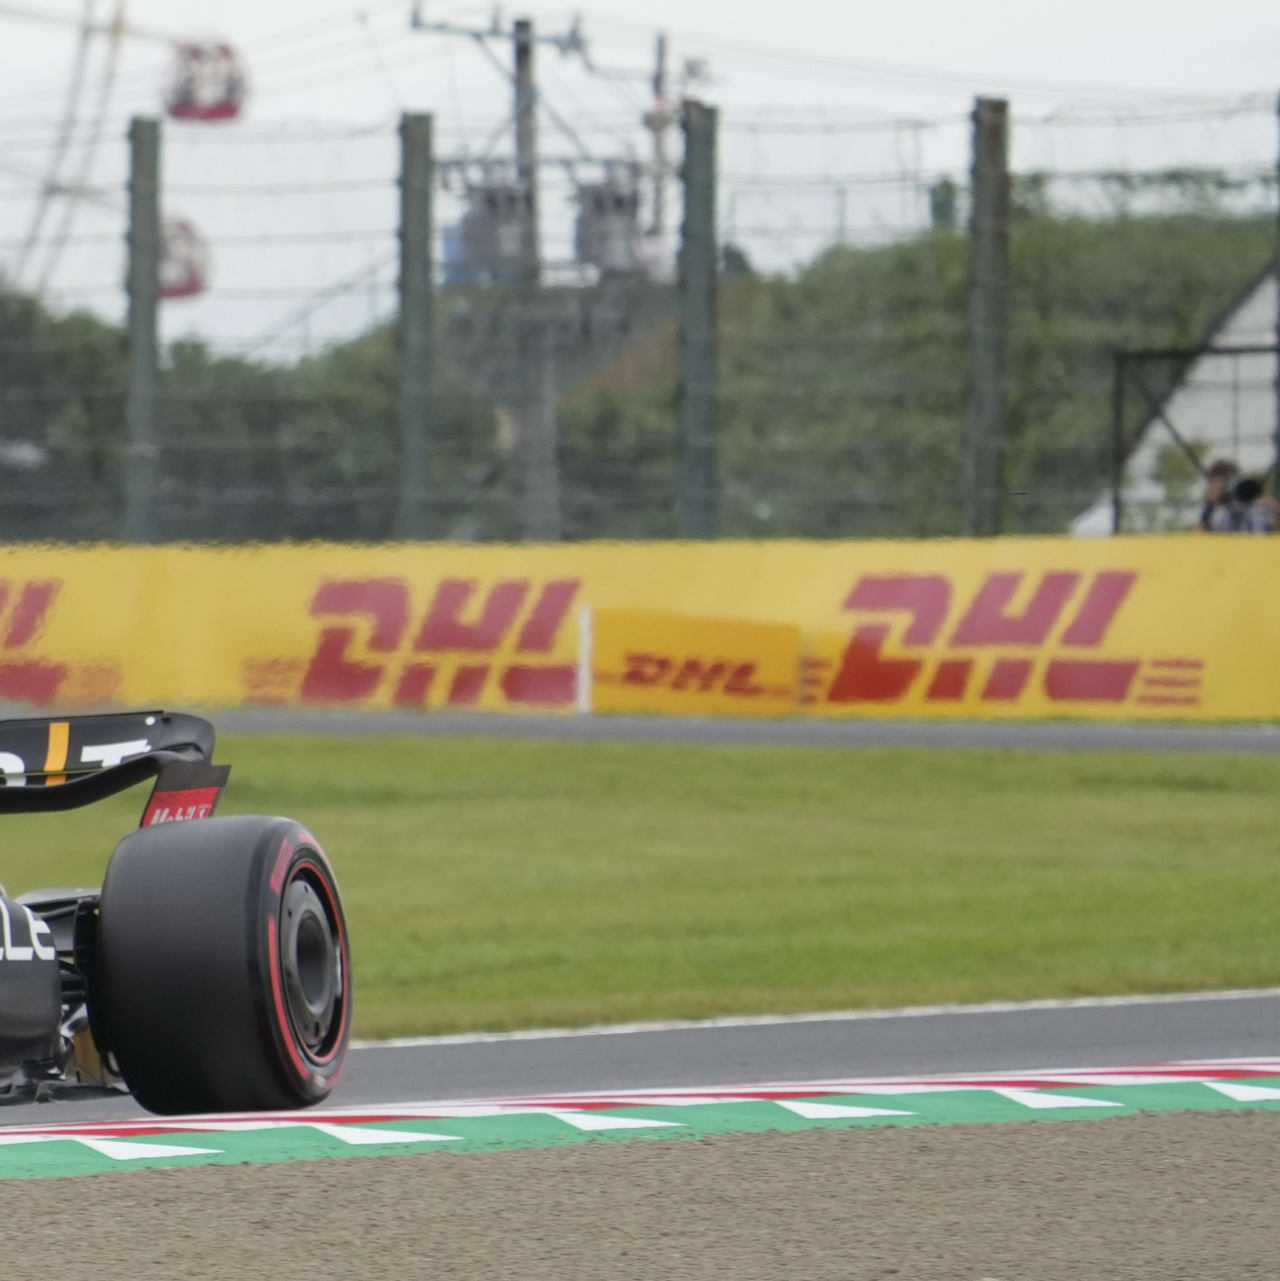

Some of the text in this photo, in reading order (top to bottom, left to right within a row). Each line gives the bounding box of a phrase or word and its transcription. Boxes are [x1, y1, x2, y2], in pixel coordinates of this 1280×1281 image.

[301, 579, 580, 705] DHL
[623, 652, 763, 697] DHL
[827, 570, 1138, 704] DHL
